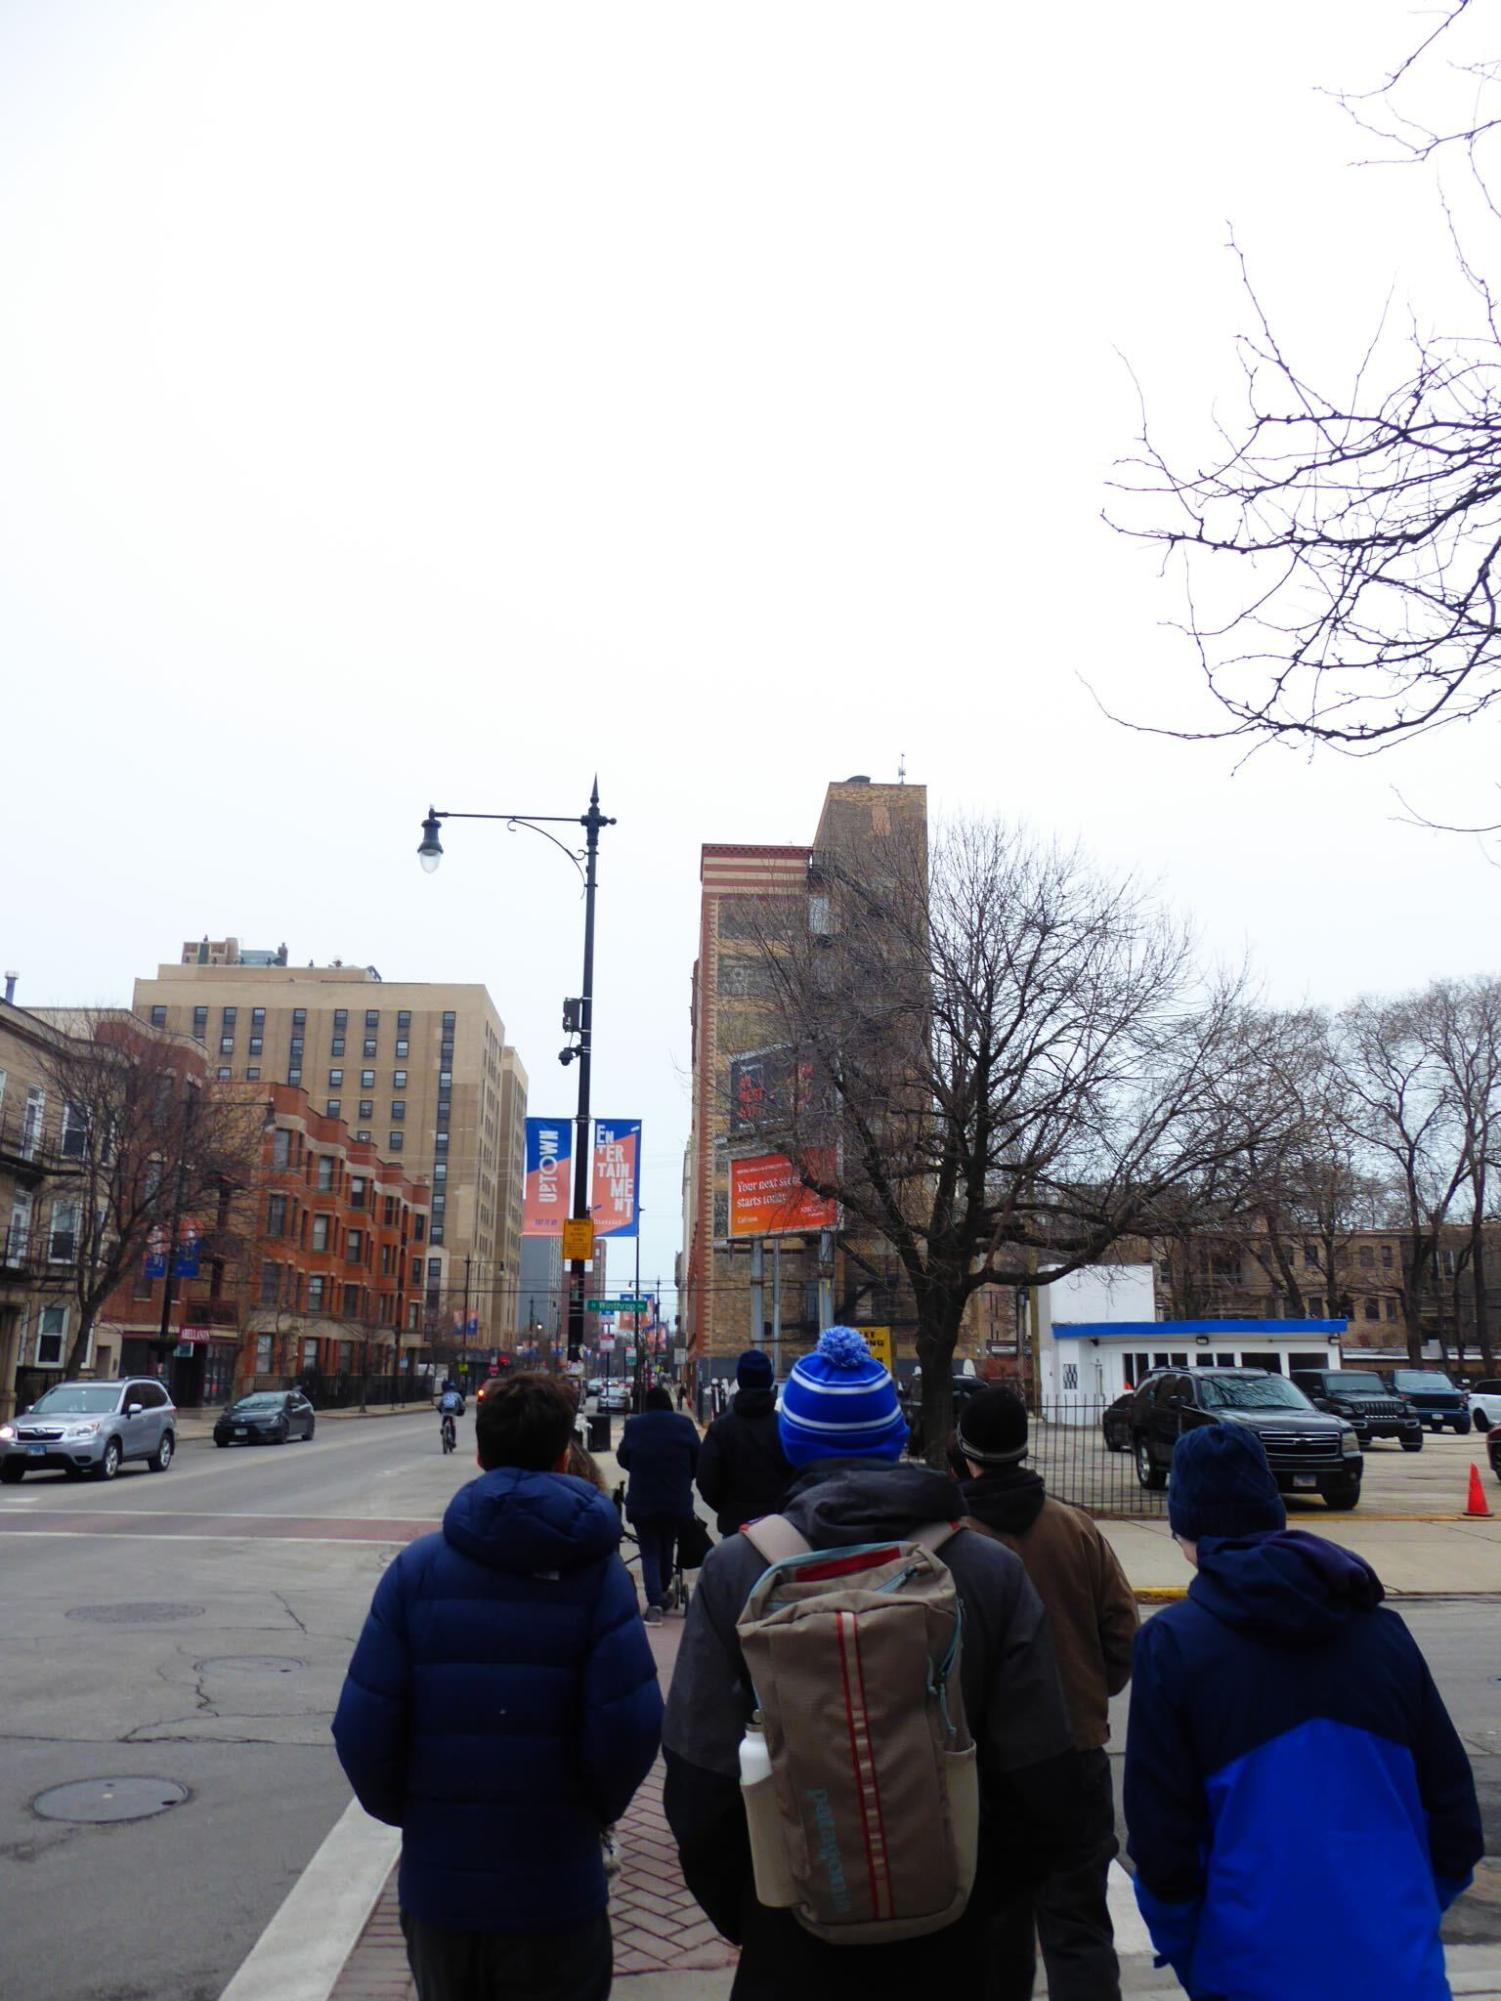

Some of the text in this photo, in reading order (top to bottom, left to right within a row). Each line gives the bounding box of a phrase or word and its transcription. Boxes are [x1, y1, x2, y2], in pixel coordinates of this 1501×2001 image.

[596, 1124, 614, 1144] EN
[595, 1145, 625, 1163] TER
[538, 1129, 559, 1203] UPTOWN
[597, 1163, 630, 1179] TAIN
[611, 1178, 634, 1198] ME
[737, 1181, 758, 1193] Your
[736, 1196, 762, 1208] starts
[599, 1301, 635, 1311] Winthrop
